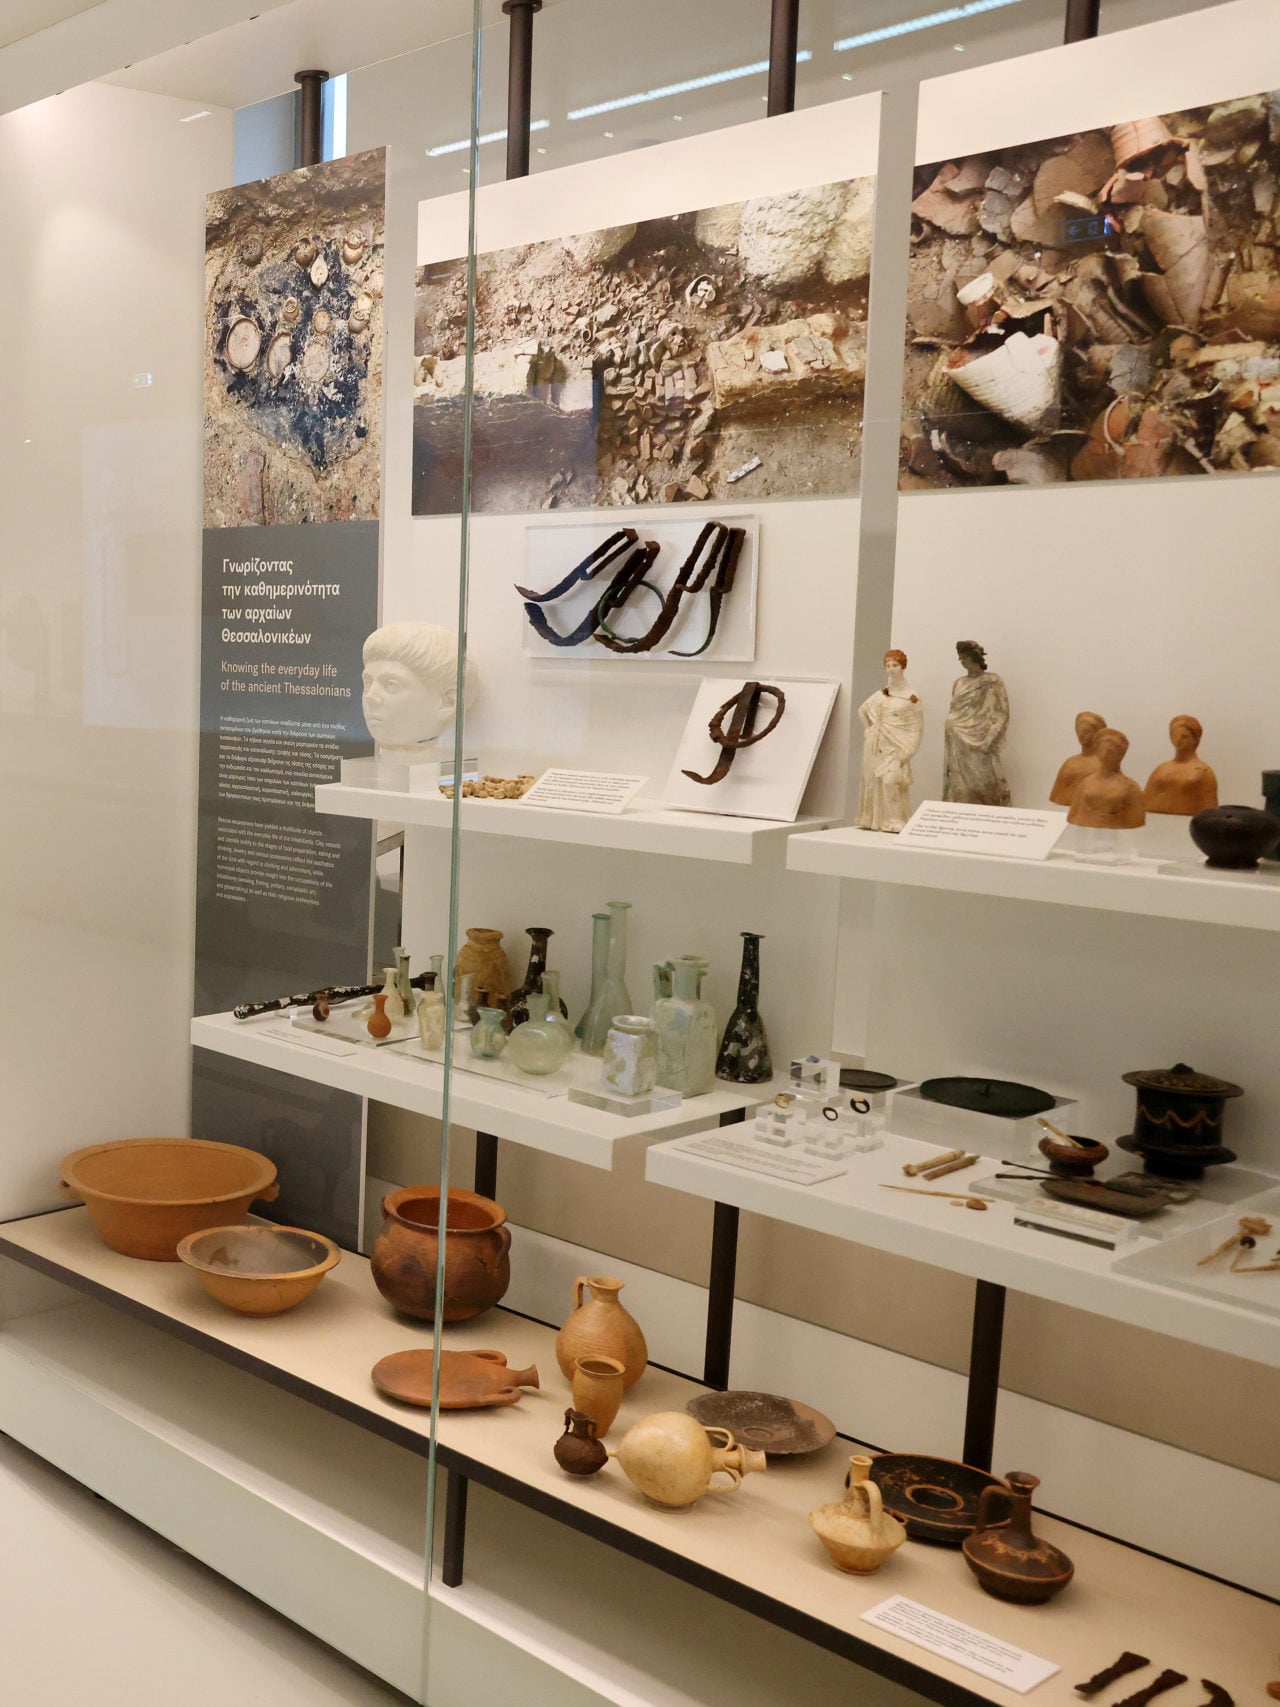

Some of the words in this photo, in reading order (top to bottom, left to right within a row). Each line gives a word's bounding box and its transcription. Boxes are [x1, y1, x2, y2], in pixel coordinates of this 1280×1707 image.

[223, 557, 294, 576] Γνωρίζοντας
[222, 585, 242, 600] την
[244, 580, 340, 600] καθημερινότητα
[221, 608, 242, 620] των
[245, 604, 292, 623] αρχαίων
[221, 628, 312, 644] Θεσσαλονικέων
[221, 661, 259, 677] Knowing
[261, 663, 276, 674] the
[278, 664, 320, 679] everyday
[322, 664, 338, 677] life
[220, 681, 231, 691] of
[232, 681, 246, 692] the
[248, 683, 282, 694] ancient
[284, 682, 352, 698] Thessalonians
